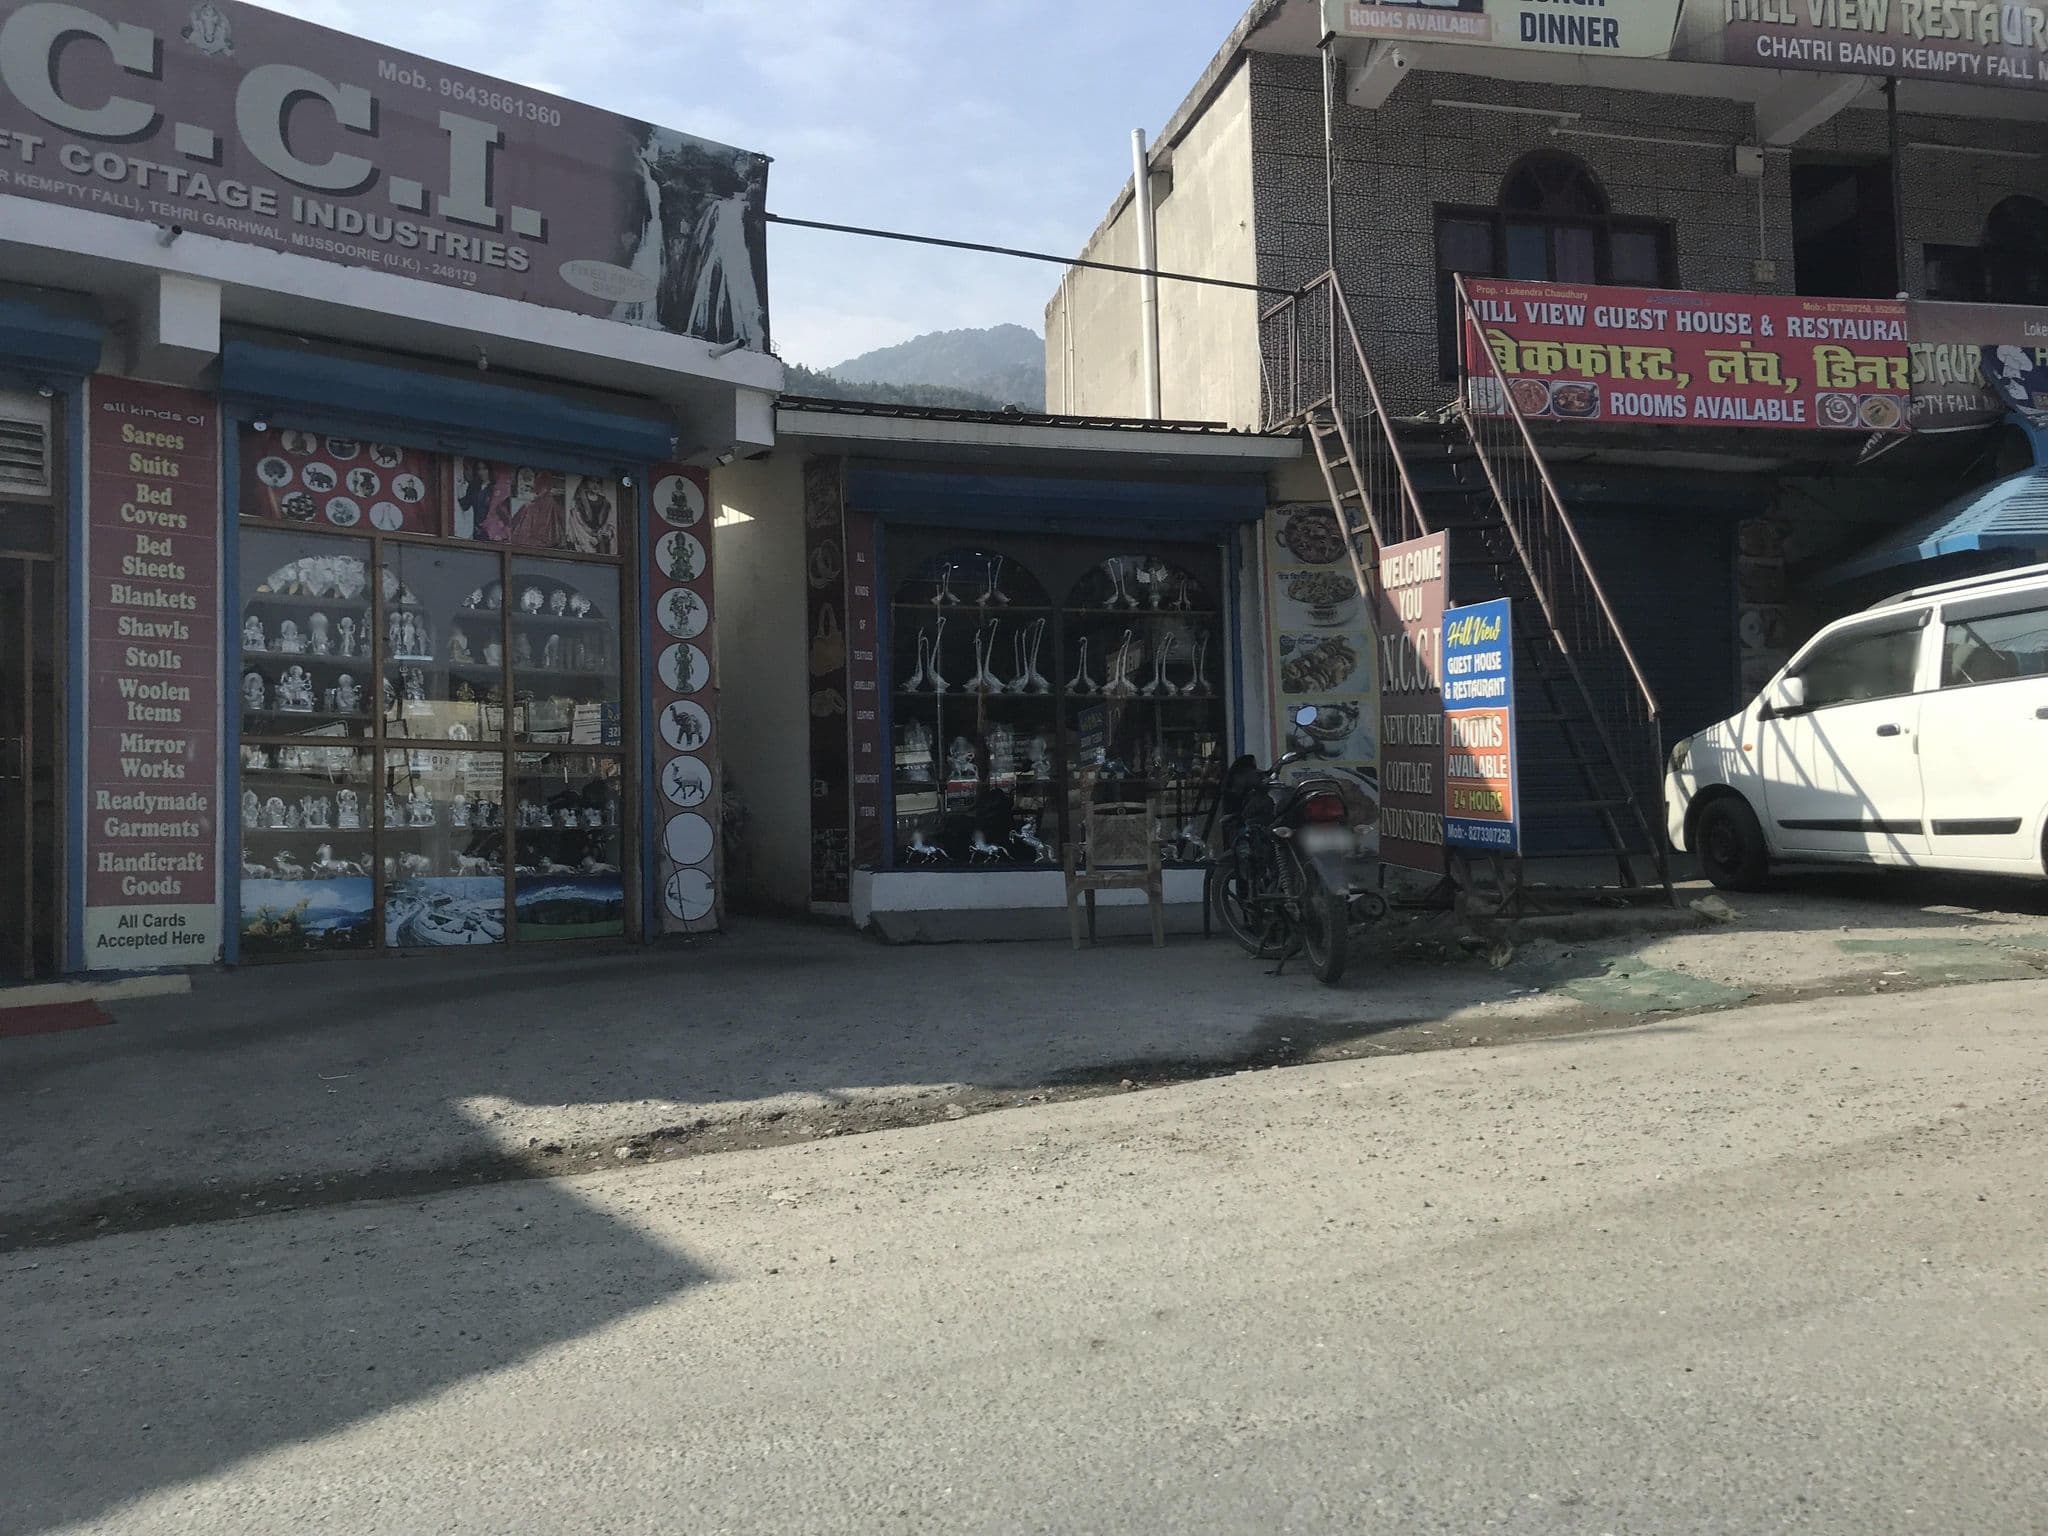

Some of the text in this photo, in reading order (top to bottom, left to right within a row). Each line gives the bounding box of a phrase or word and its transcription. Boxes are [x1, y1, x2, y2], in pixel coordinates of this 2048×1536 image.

[1349, 8, 1485, 33] ROOMS AVAILABL
[1807, 0, 1889, 32] VIEW
[1520, 12, 1620, 48] DINNER
[1756, 35, 1832, 61] CHATRI
[1839, 42, 1896, 67] BAND
[1902, 47, 1980, 75] KEMPTY
[1987, 55, 2034, 80] FALL
[378, 60, 560, 127] Mob. 9643661360
[15, 173, 87, 199] KEMPTY
[148, 200, 199, 222] TEHRI
[203, 212, 287, 243] GARHWAL,
[292, 233, 380, 262] MUSSOORIE
[60, 144, 278, 216] COTTAGE
[293, 196, 530, 272] INDUSTRIES
[1523, 301, 1587, 326] VIEW
[1593, 306, 1668, 331] GUEST
[1676, 309, 1753, 335] HOUSE
[1760, 315, 1774, 337] &
[1705, 341, 1798, 393] लंच,
[1812, 344, 1910, 390] डिनर
[103, 402, 126, 413] all
[130, 405, 182, 422] kinds
[1610, 392, 1806, 423] ROOMS AVAILABLE
[122, 423, 184, 450] Sarees
[129, 452, 179, 477] Suits
[136, 483, 172, 506] Bed
[121, 502, 187, 529] Covers
[136, 534, 172, 557] Bed
[122, 556, 185, 580] Sheets
[1382, 545, 1442, 590] WELCOME
[110, 583, 197, 610] Blankets
[1398, 586, 1423, 622] YOU
[118, 616, 189, 640] Shawls
[1447, 616, 1502, 649] Hill View
[125, 647, 181, 669] Stolls
[1447, 651, 1502, 674] GUEST HOUSE
[118, 678, 191, 701] Woolen
[1444, 677, 1506, 700] & RESTAURANT
[127, 701, 182, 722] Items
[1383, 713, 1441, 745] NEW CRAFT
[1450, 715, 1503, 748] ROOMS
[120, 732, 186, 754] Mirror
[120, 757, 185, 779] Works
[1386, 760, 1432, 794] COTTAGE
[1447, 754, 1508, 778] AVAILABLE
[95, 790, 208, 815] Readymade
[1453, 790, 1503, 811] 24 HOURS
[104, 816, 199, 838] Garments
[1381, 807, 1443, 846] INDUSTRIES
[97, 851, 204, 872] Handicraft
[121, 875, 182, 896] Goods
[118, 913, 187, 929] All Cards
[96, 930, 205, 949] Accepted Here
